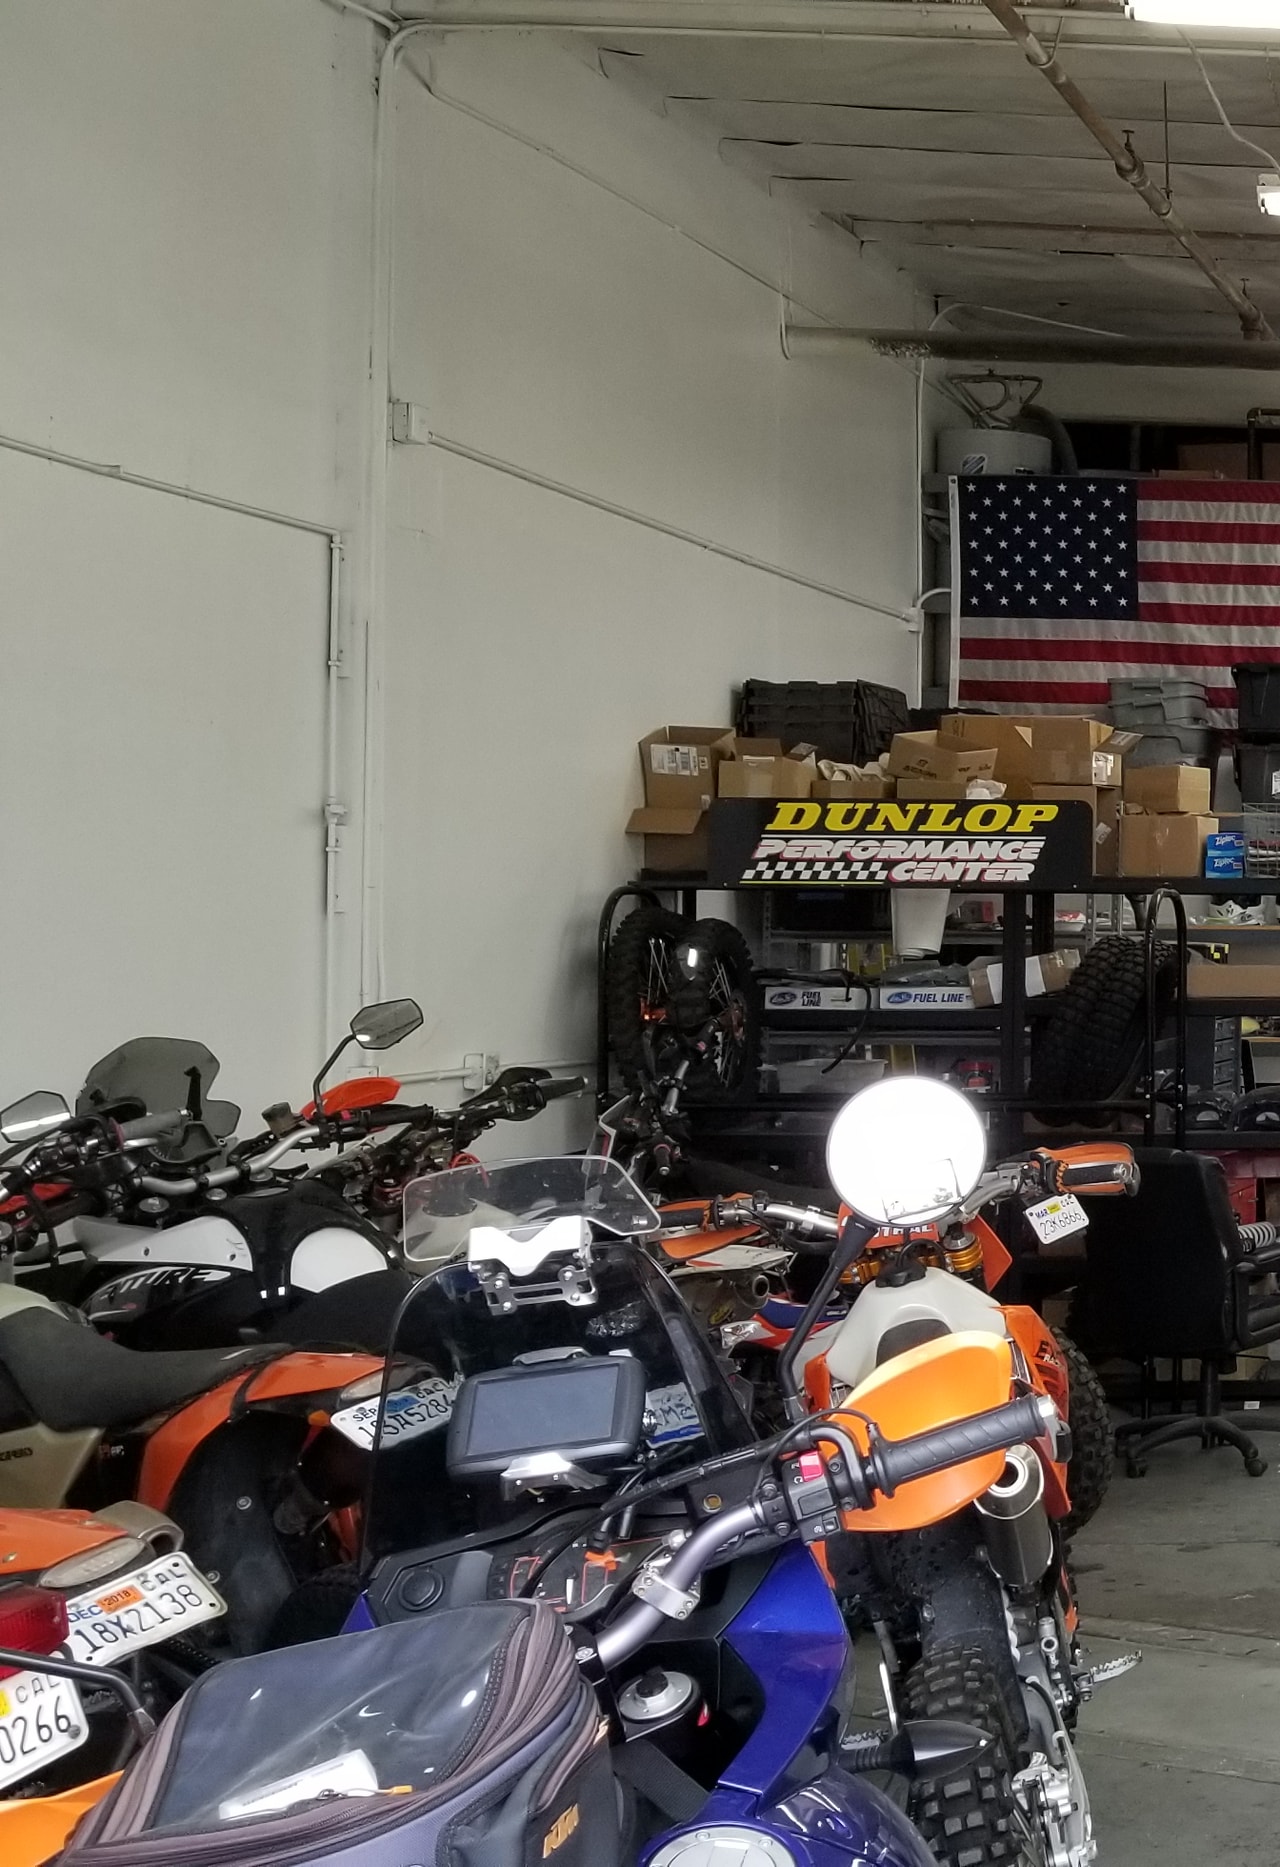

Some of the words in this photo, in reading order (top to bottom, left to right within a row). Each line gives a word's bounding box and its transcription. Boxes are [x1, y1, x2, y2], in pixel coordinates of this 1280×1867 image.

[764, 802, 1059, 833] DUNLOP
[752, 839, 1046, 861] PERFORMANCE
[1215, 835, 1236, 846] Ziploc
[888, 861, 1036, 883] CENTER
[1213, 857, 1235, 868] Ziploc
[801, 991, 822, 999] FUEL
[801, 999, 822, 1007] LINE
[912, 993, 938, 1003] FUEL
[940, 993, 964, 1003] LINE
[1040, 1208, 1082, 1236] 23K6866
[352, 1406, 378, 1423] SEP
[67, 1603, 103, 1623] DEC
[103, 1588, 132, 1607] 2018
[136, 1567, 187, 1593] CAL
[74, 1584, 203, 1654] 18X2138
[15, 1674, 60, 1704] CAL
[542, 1803, 580, 1859] KTM
